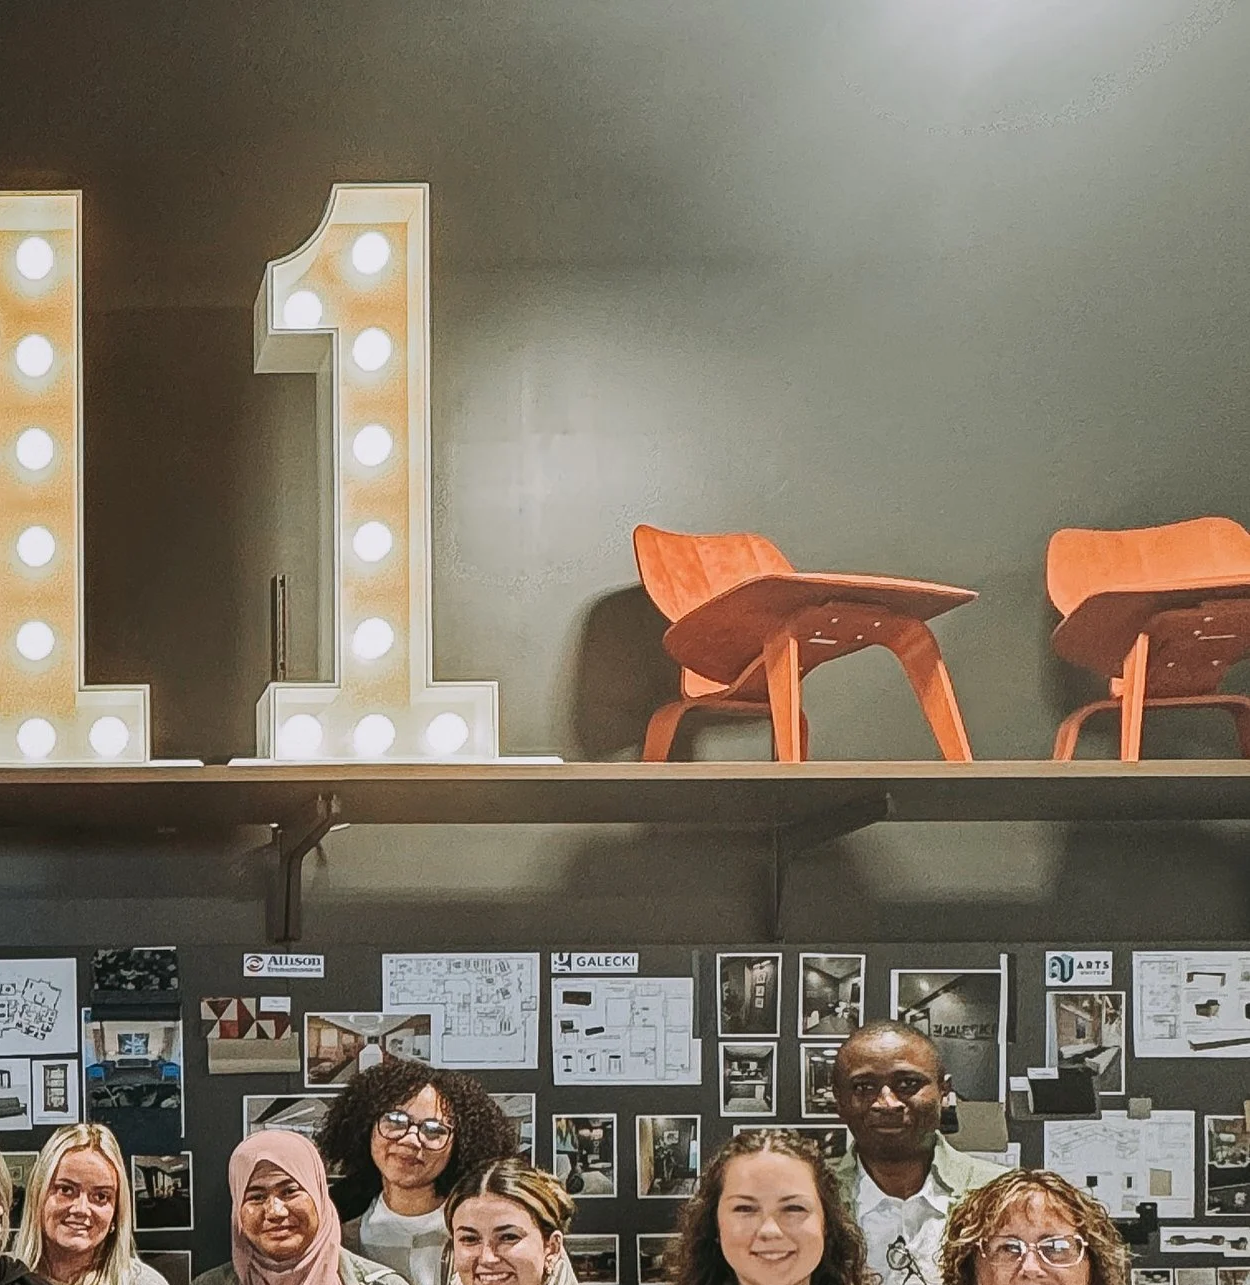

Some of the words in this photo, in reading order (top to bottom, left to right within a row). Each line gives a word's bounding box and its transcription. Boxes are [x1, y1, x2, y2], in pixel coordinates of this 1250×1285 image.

[268, 956, 321, 967] Allison
[576, 956, 635, 967] GALECKI
[1076, 961, 1110, 970] ARTS
